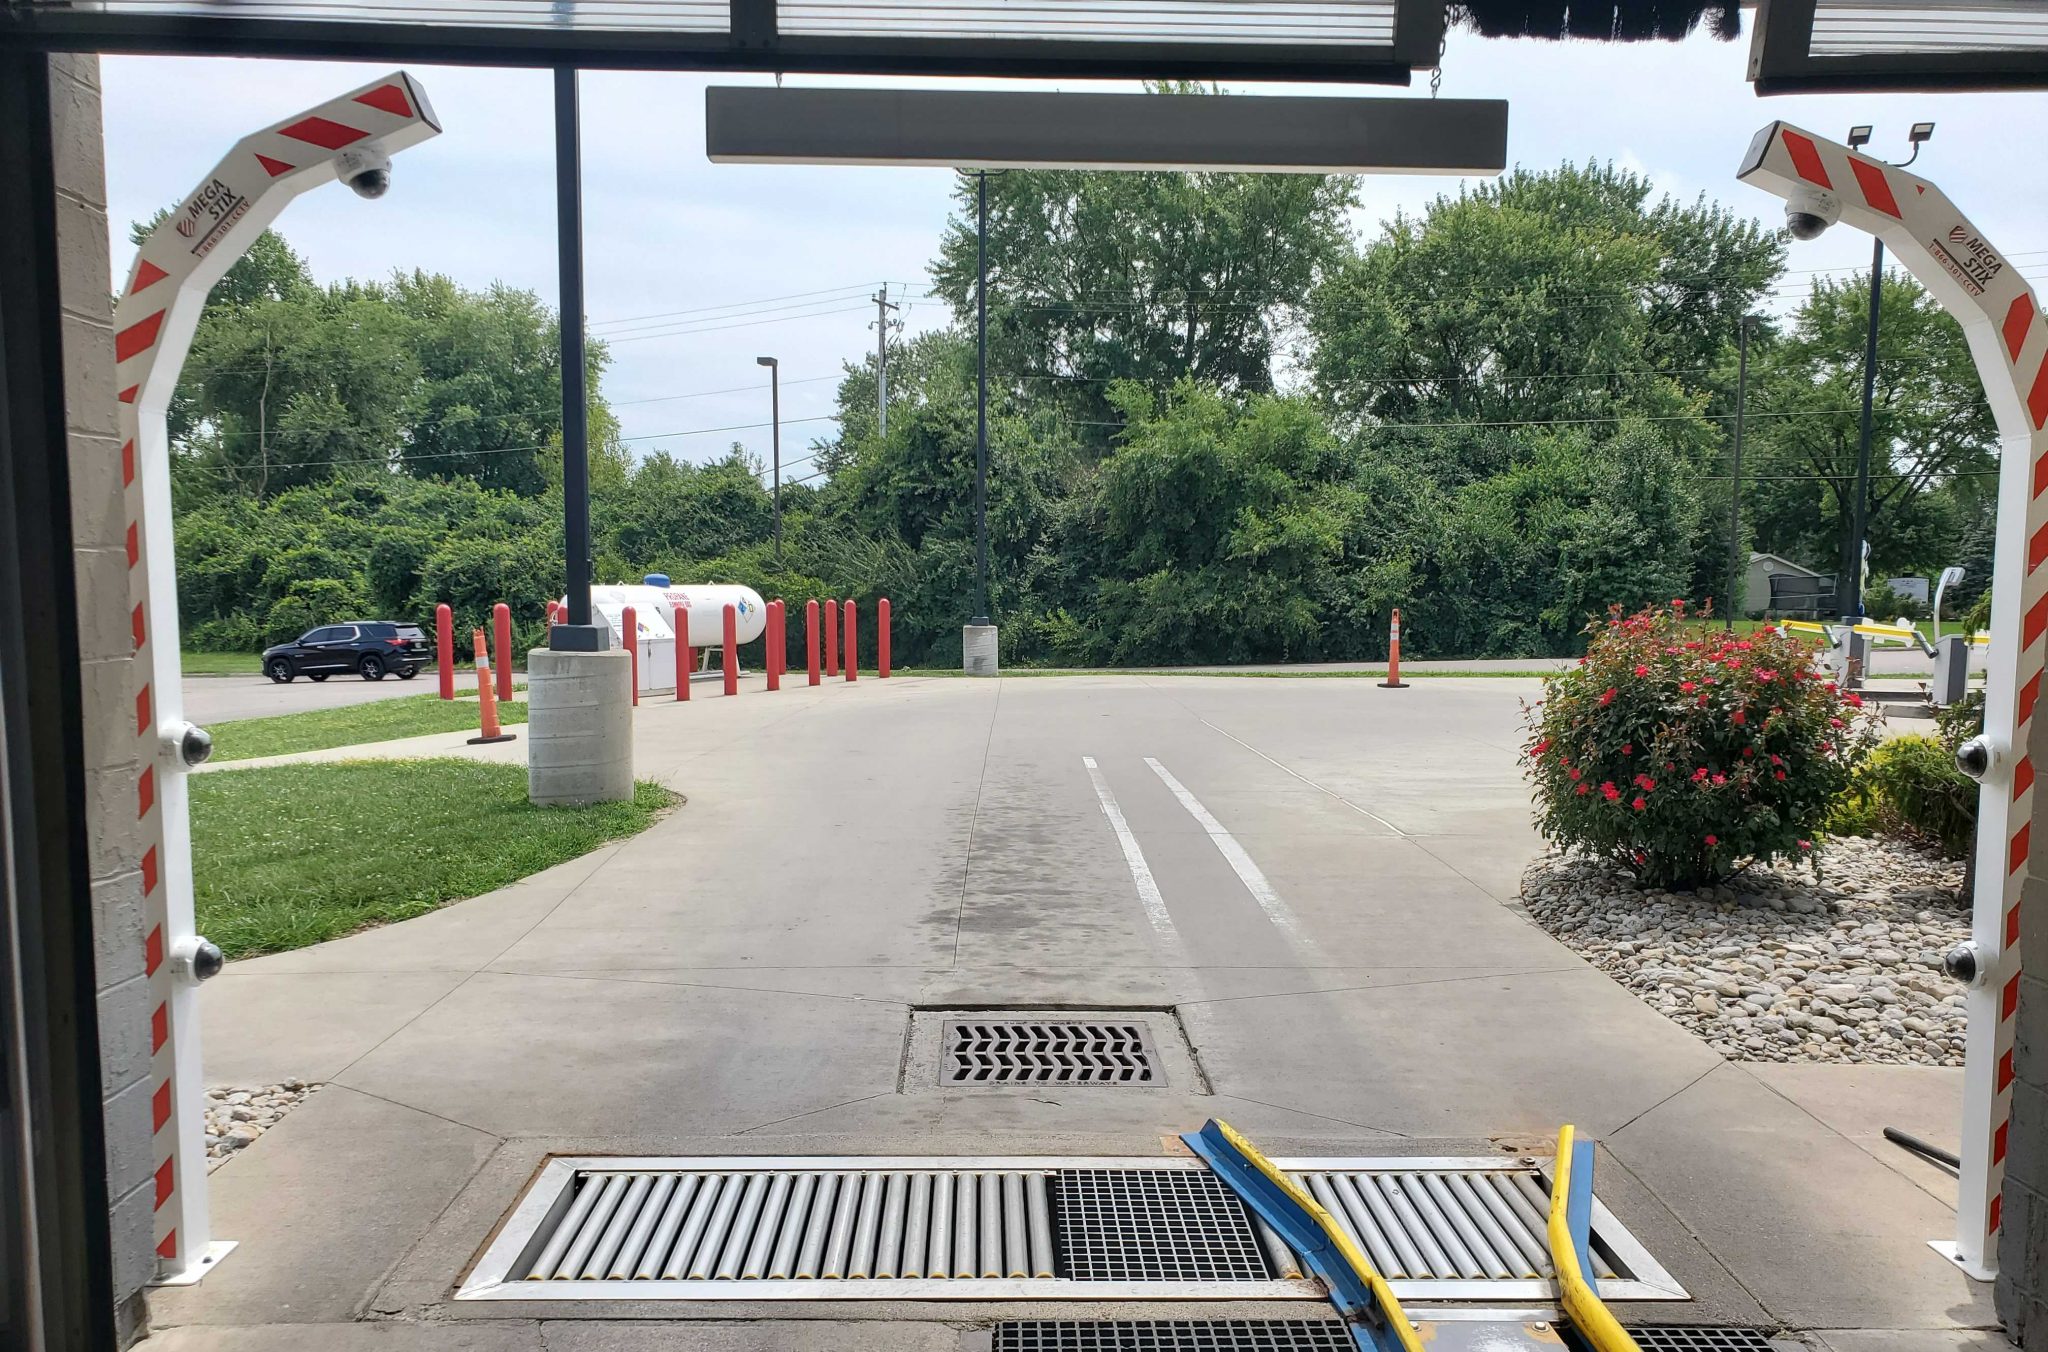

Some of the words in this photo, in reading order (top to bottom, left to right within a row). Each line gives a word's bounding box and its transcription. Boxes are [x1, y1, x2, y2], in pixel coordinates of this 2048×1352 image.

[188, 179, 224, 218] MEGA
[209, 187, 236, 220] STIX
[1928, 243, 1981, 297] 1-866-301-CCTV
[1963, 257, 1993, 286] STIX
[1966, 238, 2003, 275] MEGA
